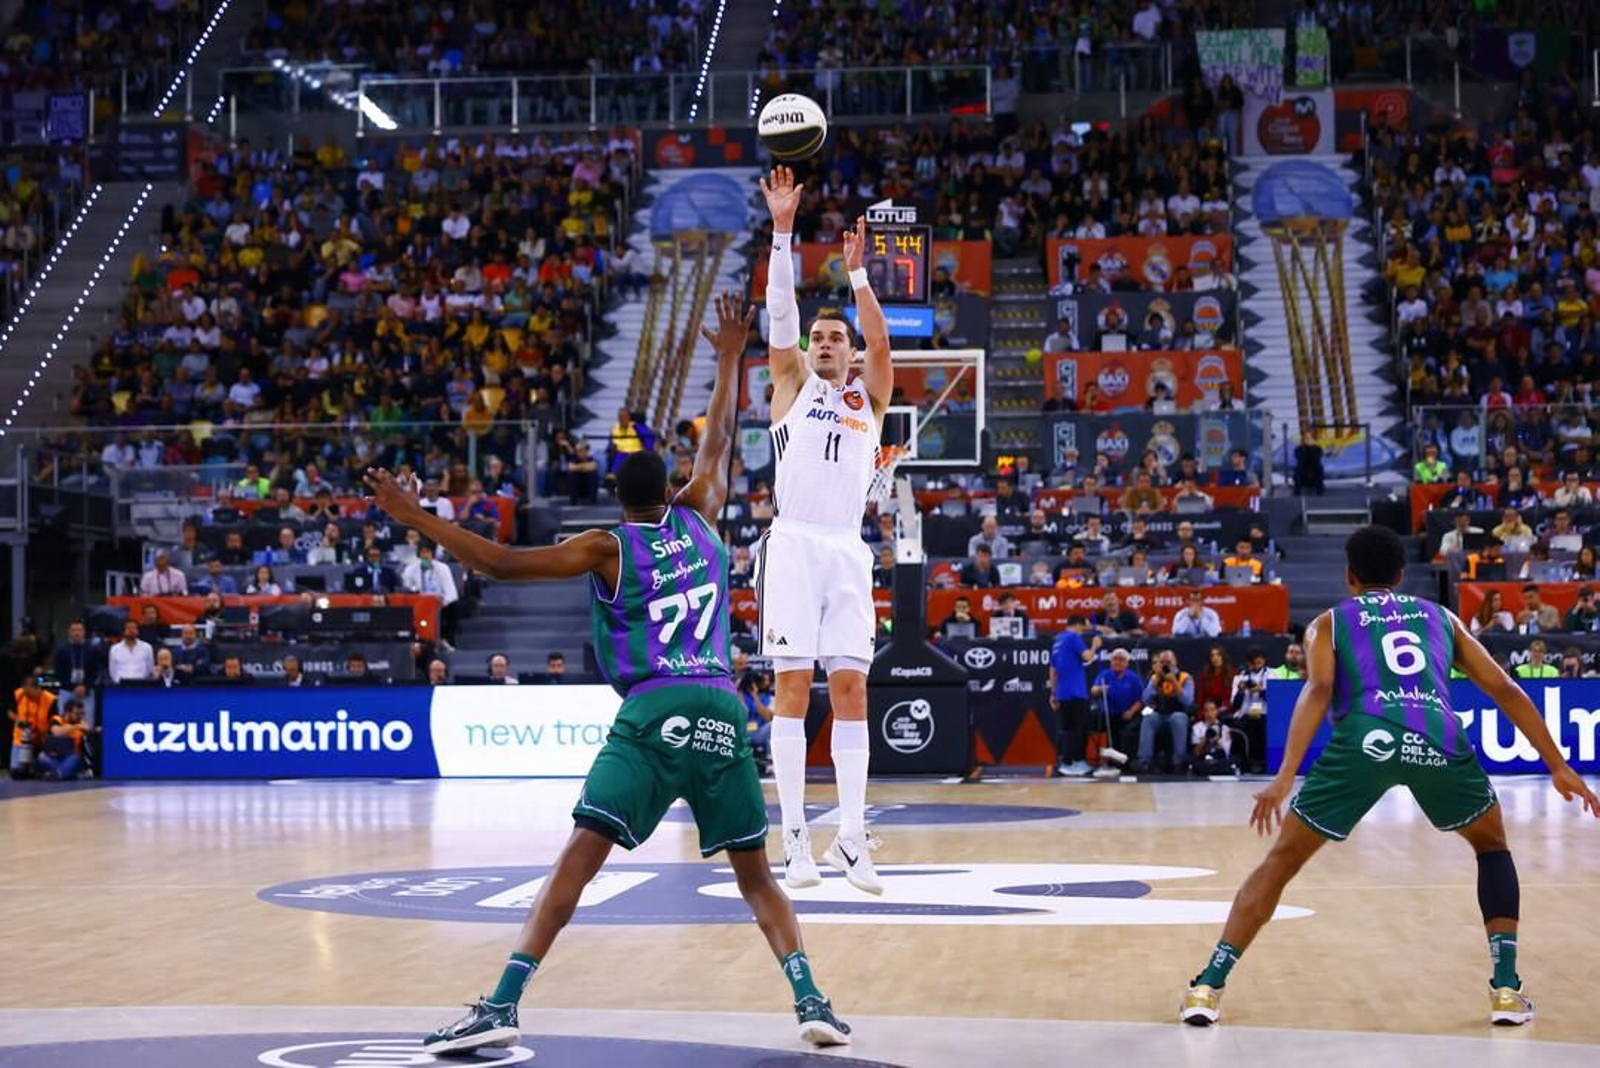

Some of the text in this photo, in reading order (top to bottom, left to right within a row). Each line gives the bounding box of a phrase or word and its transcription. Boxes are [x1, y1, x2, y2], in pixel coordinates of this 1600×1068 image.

[762, 111, 805, 125] Wilson
[866, 210, 916, 222] LOTUS
[895, 258, 915, 295] 7
[824, 431, 841, 463] 11
[652, 533, 693, 558] Sima
[1353, 592, 1418, 605] Taylor
[648, 583, 718, 644] 77
[1013, 649, 1051, 665] IONO
[1381, 630, 1426, 676] 6
[123, 710, 413, 752] azulmarino
[464, 719, 612, 746] new tra
[694, 729, 735, 748] DEL SOL
[697, 717, 736, 738] COSTA
[1401, 744, 1425, 756] DEL
